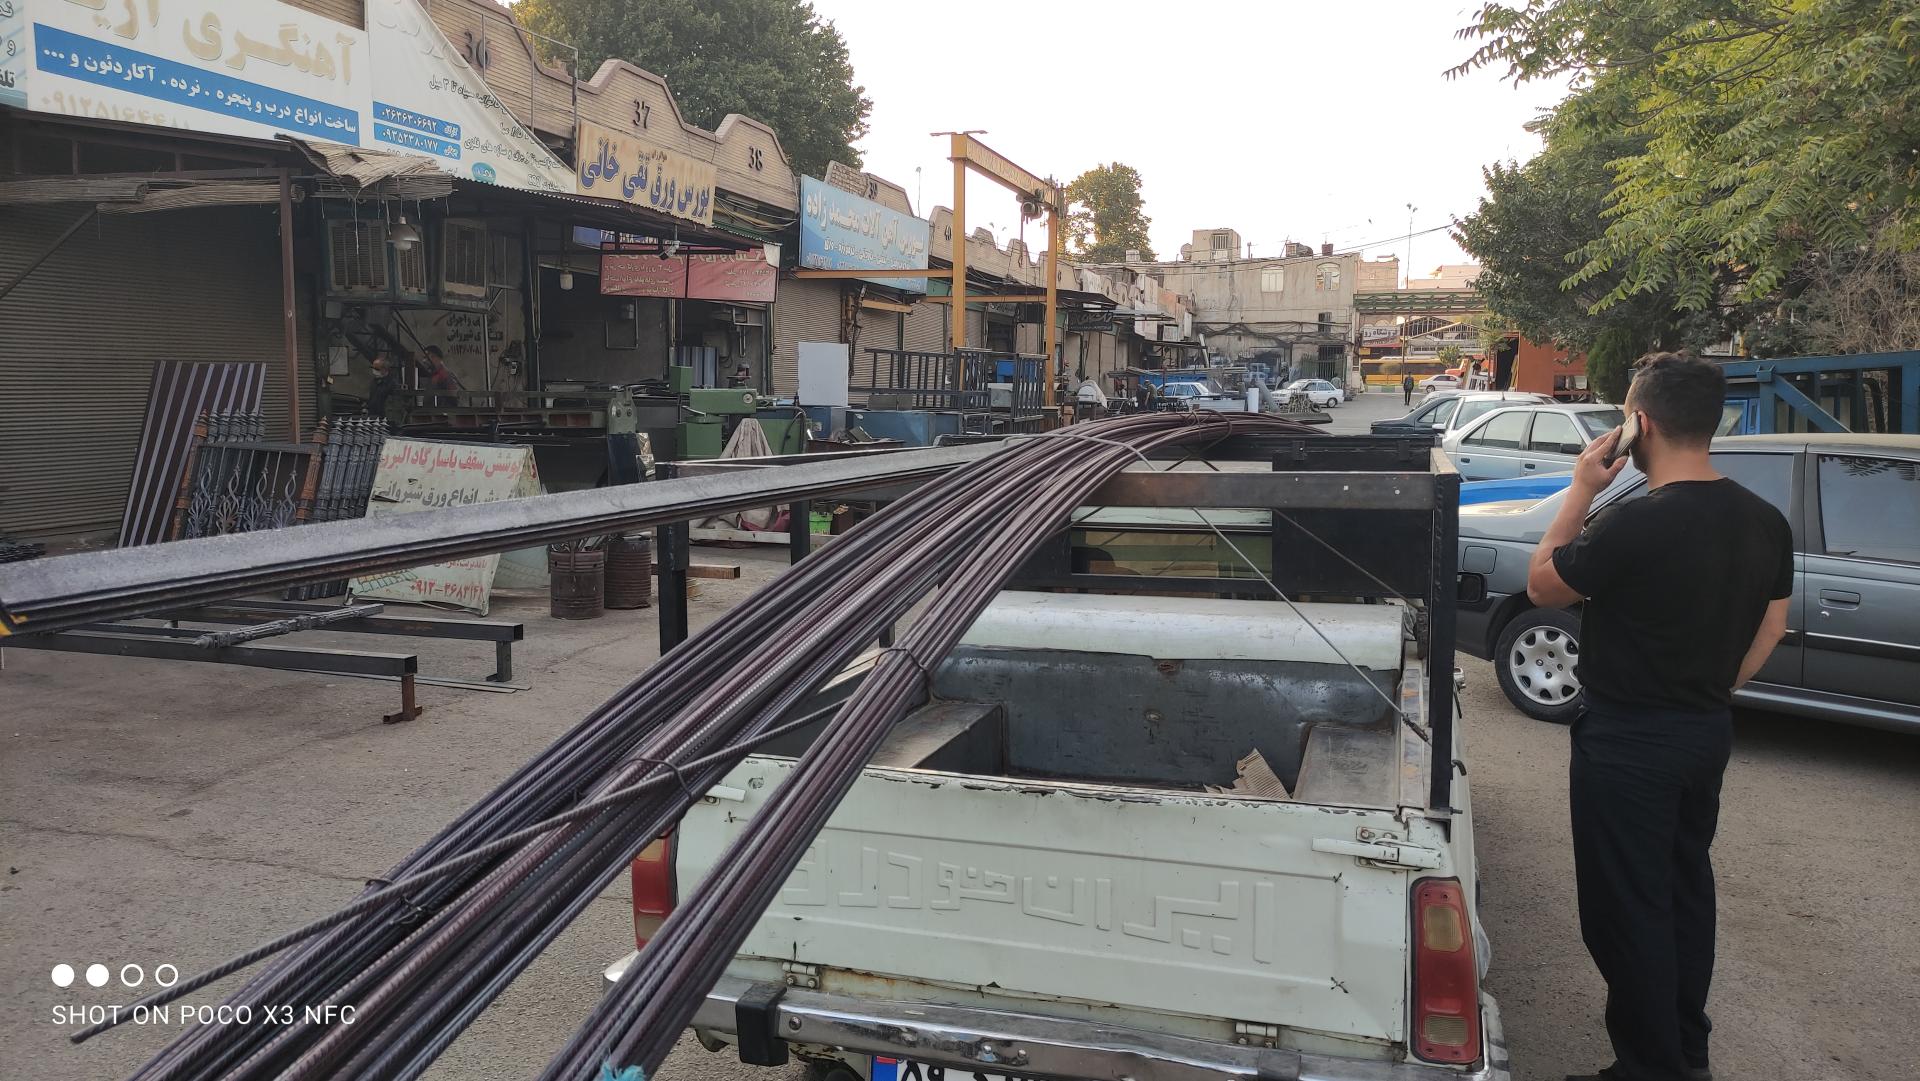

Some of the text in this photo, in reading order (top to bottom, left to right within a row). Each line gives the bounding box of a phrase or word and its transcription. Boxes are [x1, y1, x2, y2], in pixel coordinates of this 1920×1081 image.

[170, 76, 201, 97] نرده
[216, 90, 252, 113] پنجره
[265, 101, 291, 119] درب
[294, 106, 322, 125] انواع
[324, 111, 357, 134] ساخت
[632, 99, 650, 130] 37
[650, 165, 676, 210] ورق
